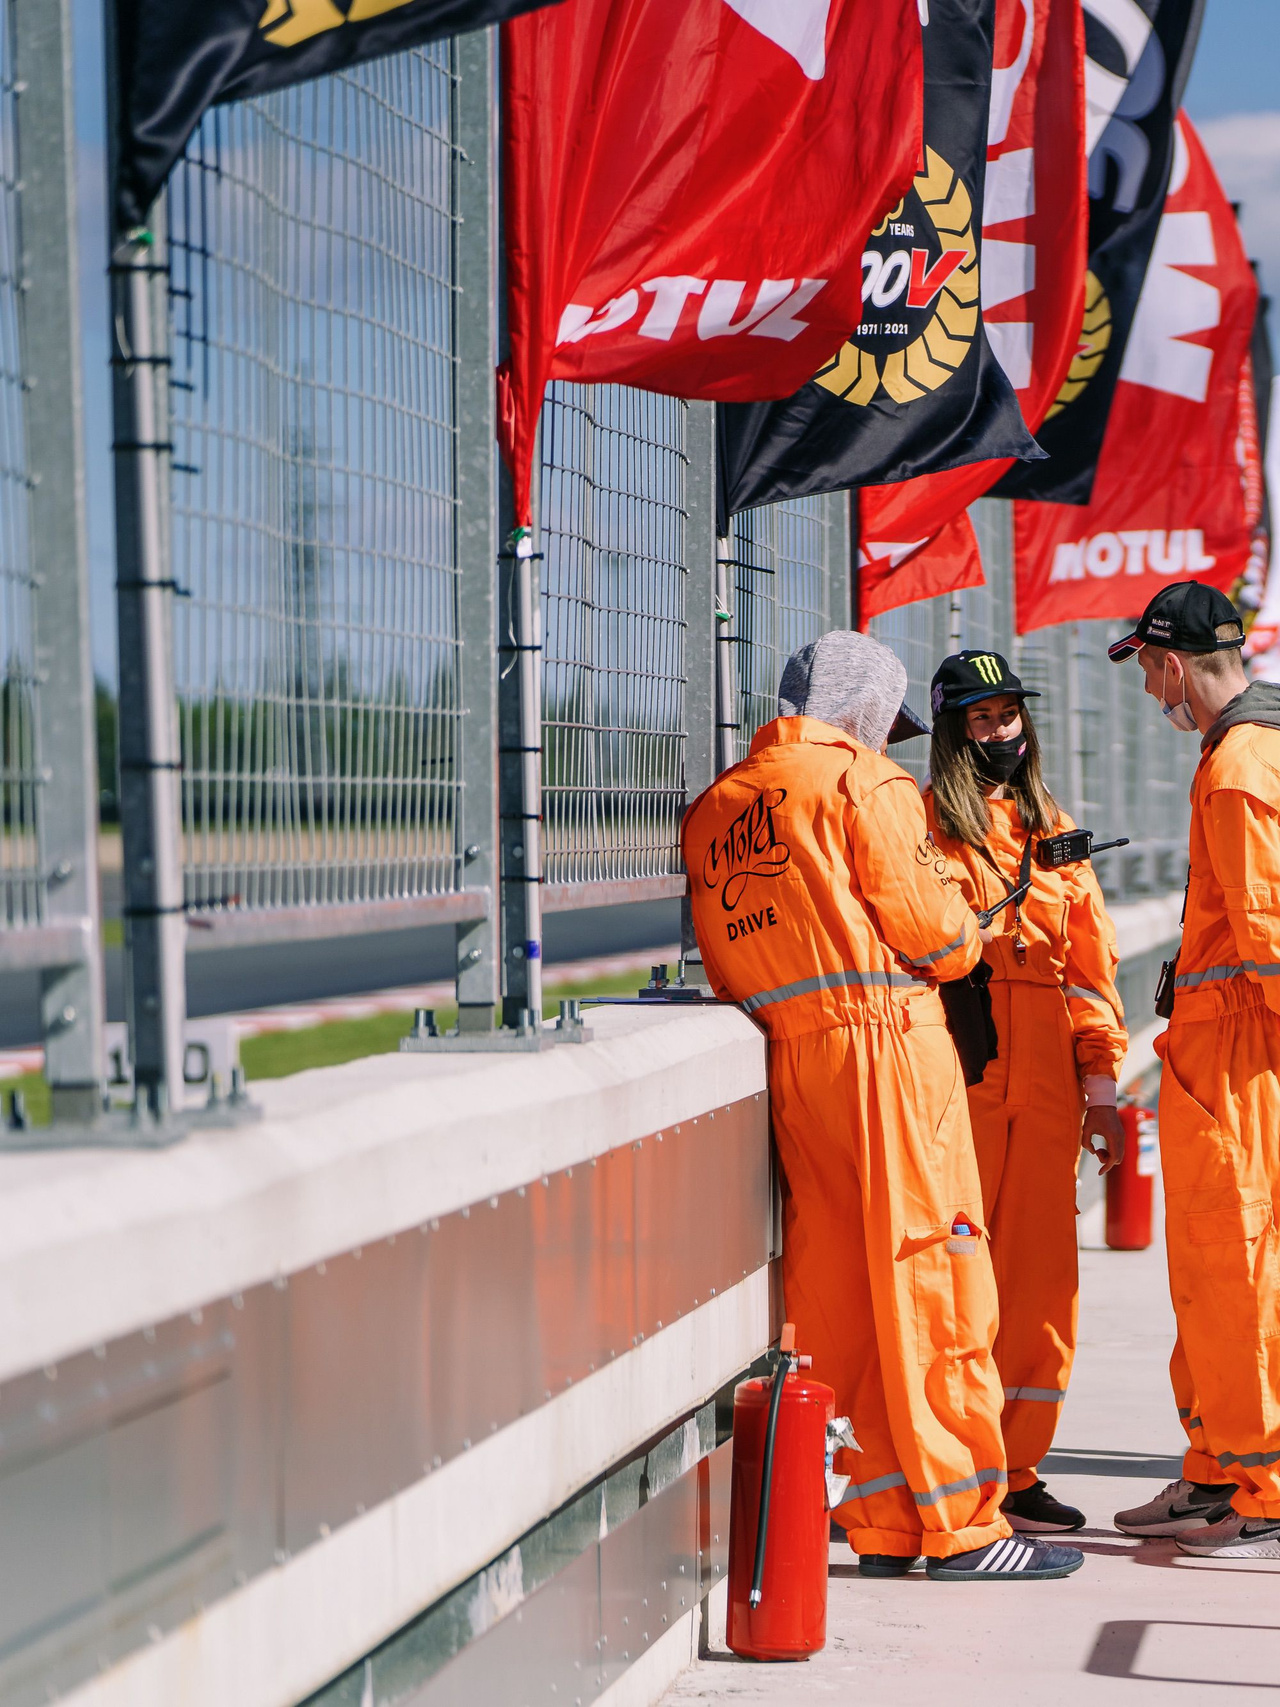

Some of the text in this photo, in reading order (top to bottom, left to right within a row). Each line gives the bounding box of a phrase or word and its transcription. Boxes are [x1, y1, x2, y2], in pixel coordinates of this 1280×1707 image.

[890, 223, 914, 237] YEARS
[861, 248, 969, 308] 00V
[857, 323, 908, 335] 1971 2021
[1050, 529, 1215, 584] MOTUL
[727, 907, 777, 941] DRIVE
[108, 1043, 209, 1083] 10
